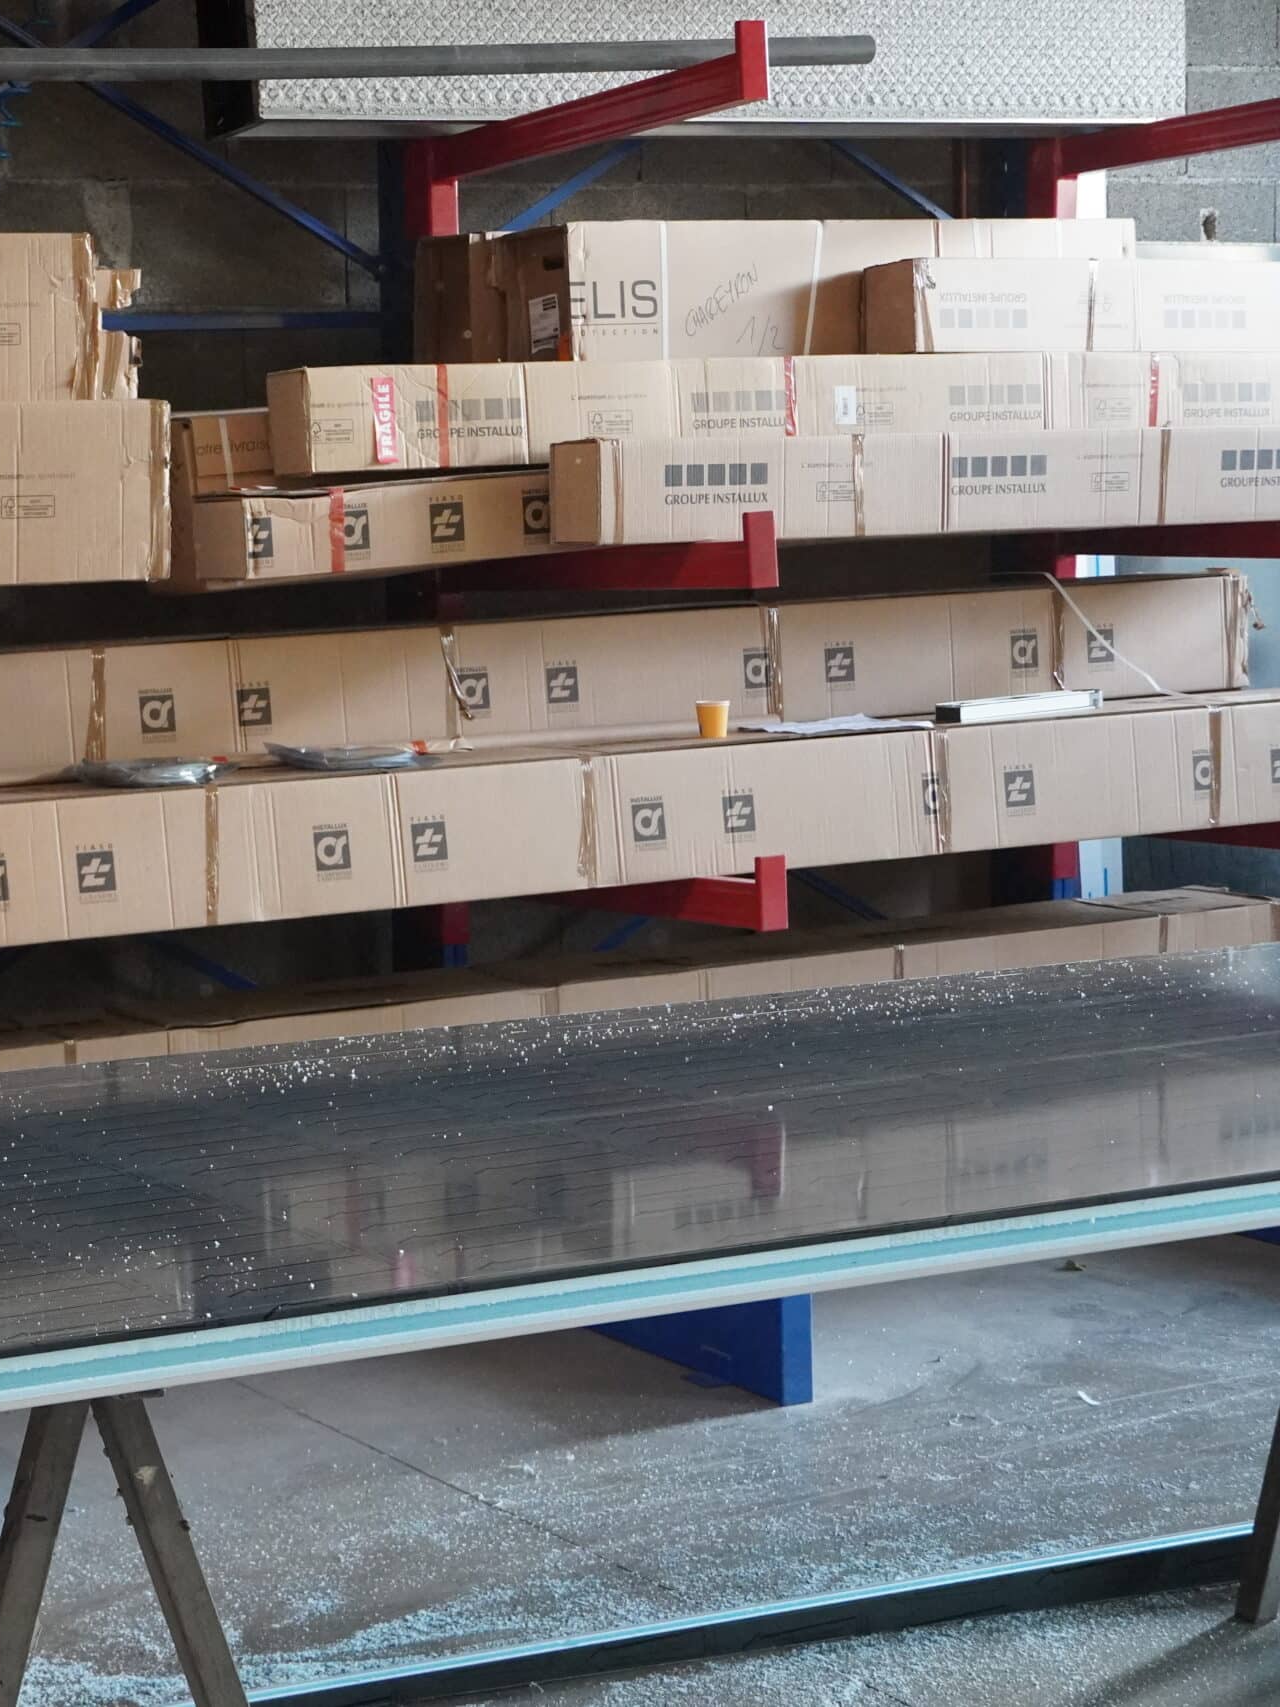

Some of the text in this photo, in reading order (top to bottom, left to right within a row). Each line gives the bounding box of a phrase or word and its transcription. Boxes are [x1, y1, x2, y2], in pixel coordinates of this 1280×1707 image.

[376, 383, 394, 458] FRAGILE
[692, 416, 787, 431] GROUPE INSTALLU
[949, 410, 991, 422] GROUPE
[416, 427, 465, 440] GROPE
[951, 482, 1048, 497] GROUPE INSTALLUX
[1220, 476, 1260, 489] GROUPE
[664, 490, 769, 506] GROUPE INSTALLUX
